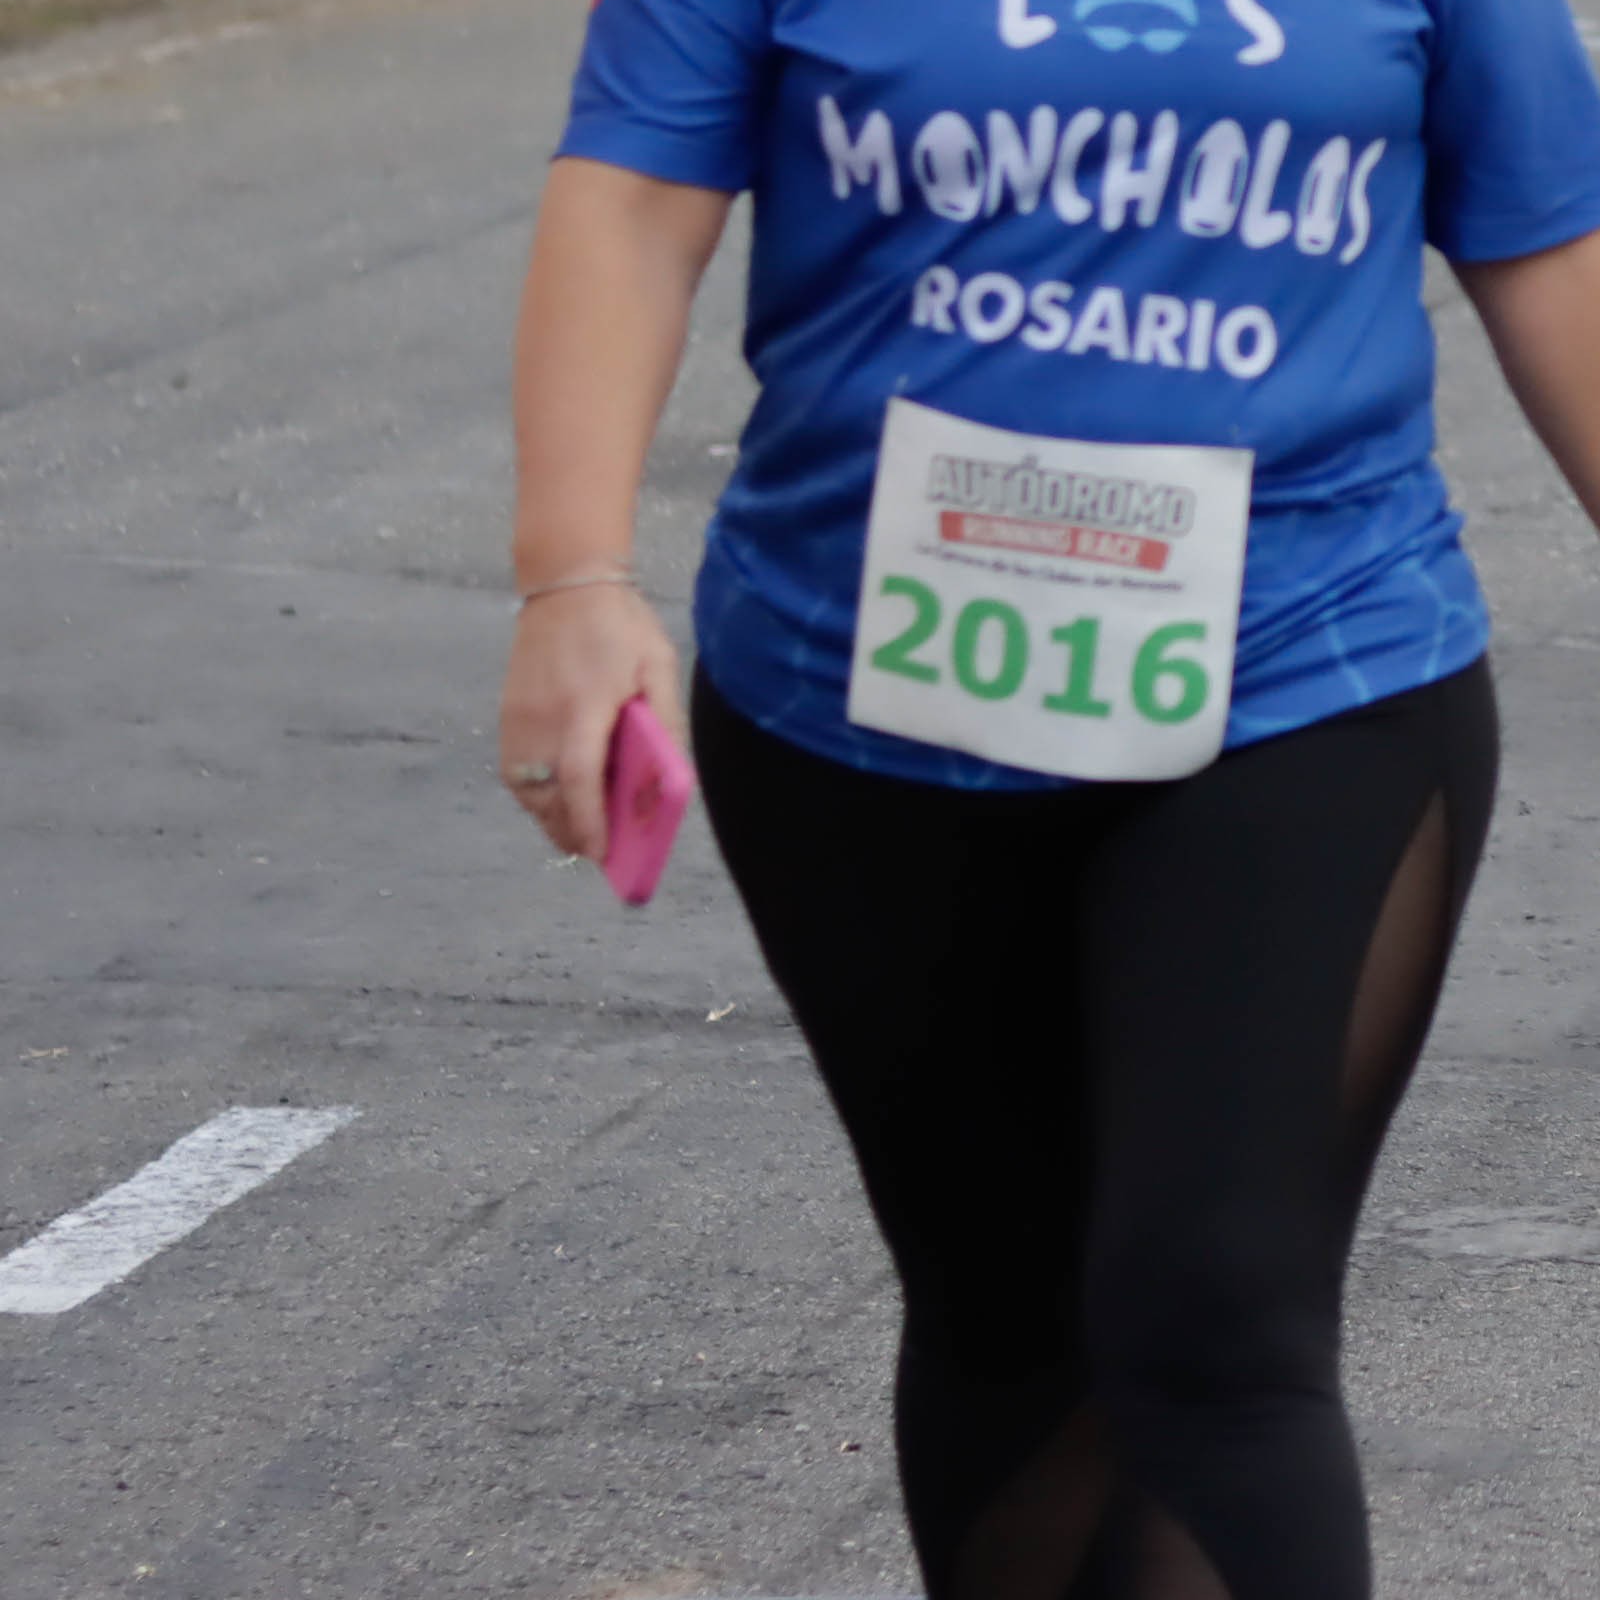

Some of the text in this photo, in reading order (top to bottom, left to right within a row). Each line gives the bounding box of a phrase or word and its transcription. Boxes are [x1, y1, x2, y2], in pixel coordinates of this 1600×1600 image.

[817, 93, 1388, 266] MONCHOLOS
[911, 264, 1279, 379] ROSARIO
[869, 576, 1213, 727] 2016
